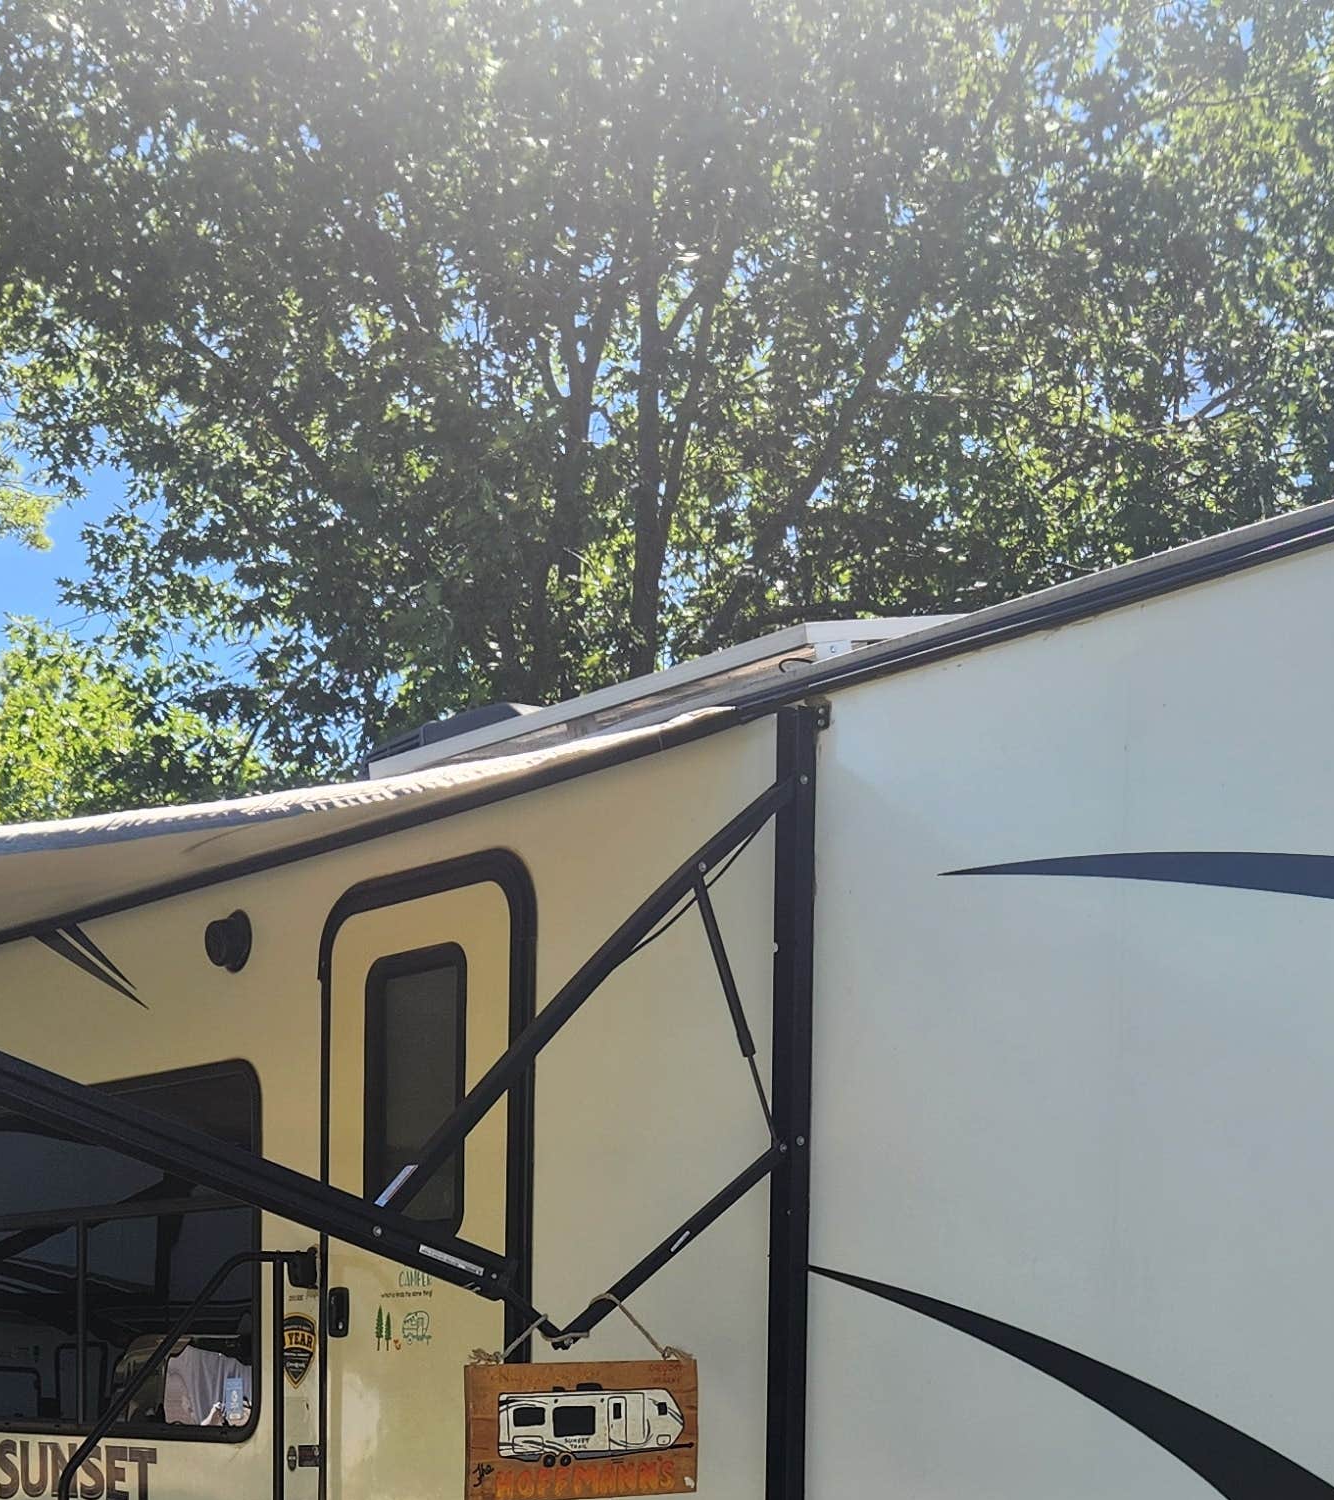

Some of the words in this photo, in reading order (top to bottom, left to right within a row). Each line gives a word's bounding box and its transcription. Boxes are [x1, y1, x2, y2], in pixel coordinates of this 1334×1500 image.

[288, 1332, 312, 1348] YEAR
[472, 1462, 494, 1487] The
[494, 1456, 675, 1498] HOFFMANN'S
